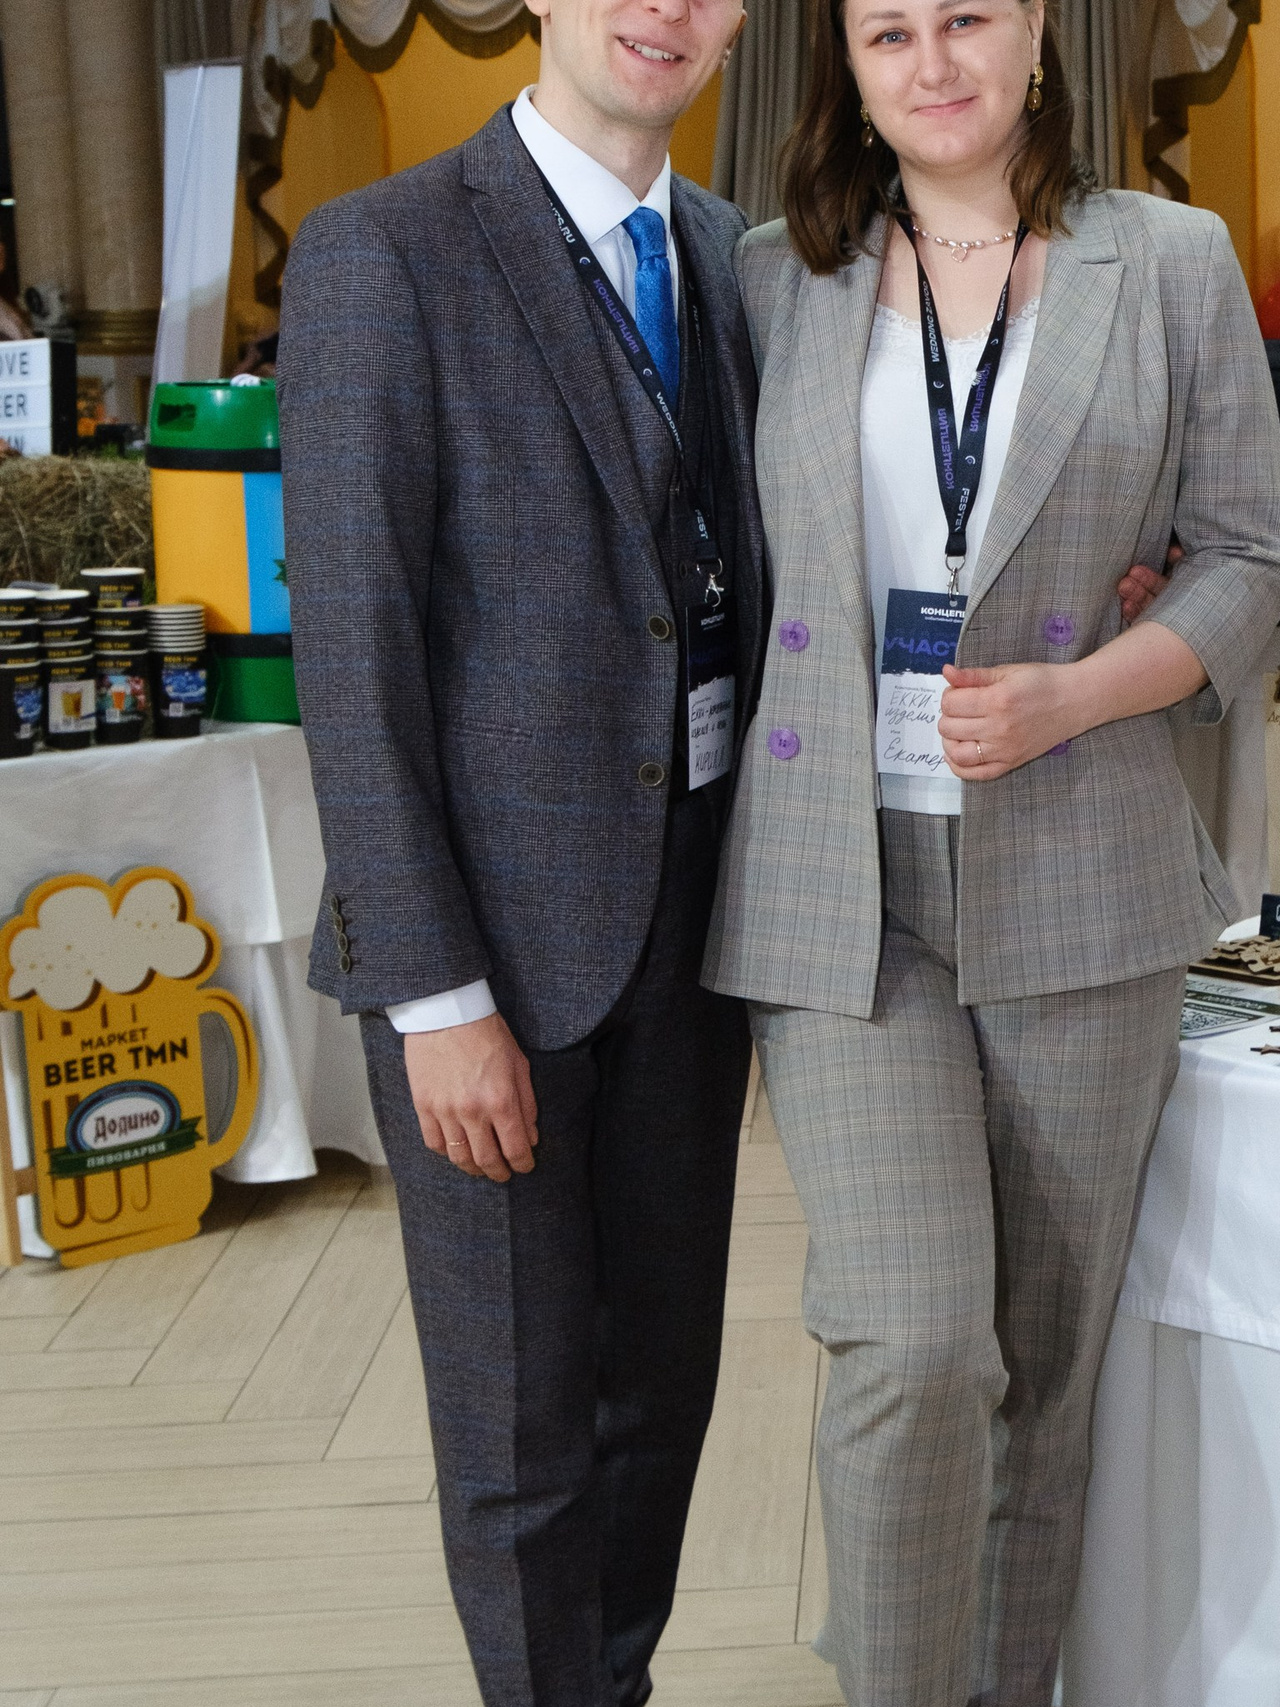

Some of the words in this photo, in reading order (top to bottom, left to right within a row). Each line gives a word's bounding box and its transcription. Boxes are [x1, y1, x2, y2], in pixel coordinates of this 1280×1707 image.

[593, 278, 640, 355] КОНЦЕПЦИЯ
[927, 315, 940, 363] WEDDING
[0, 351, 29, 376] VE
[0, 393, 27, 417] ER
[937, 408, 955, 490] КОНЦЕПЦИЯ
[884, 737, 945, 771] Екатер
[80, 1027, 148, 1050] МАРКЕТ
[44, 1052, 117, 1088] BEER
[128, 1036, 189, 1070] TMN
[93, 1108, 160, 1143] Додино
